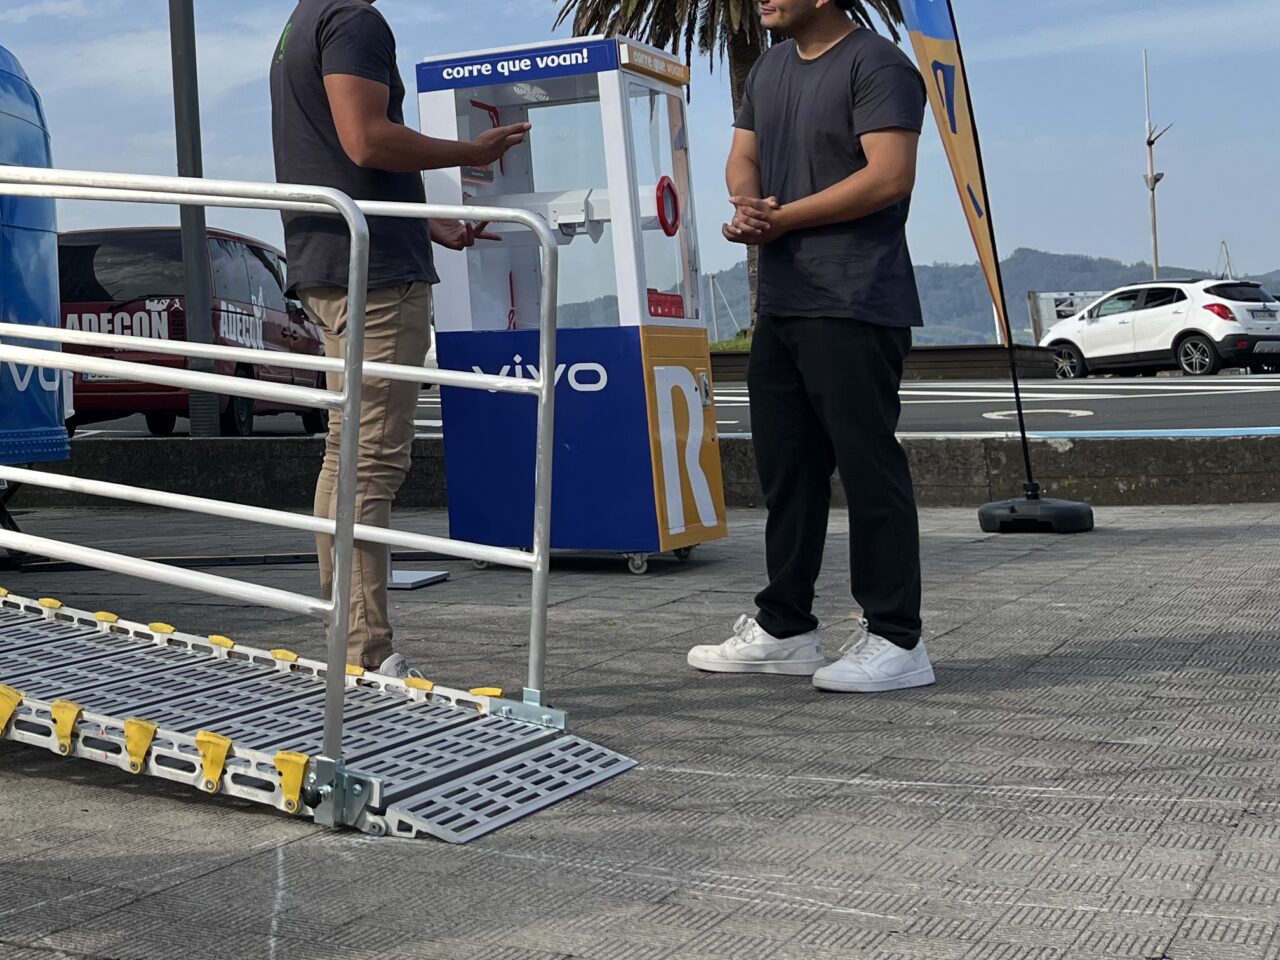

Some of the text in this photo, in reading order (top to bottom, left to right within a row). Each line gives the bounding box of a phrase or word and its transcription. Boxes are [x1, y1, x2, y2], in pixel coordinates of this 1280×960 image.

[442, 48, 589, 80] corre que voan!
[632, 50, 653, 68] corre
[652, 365, 718, 535] R
